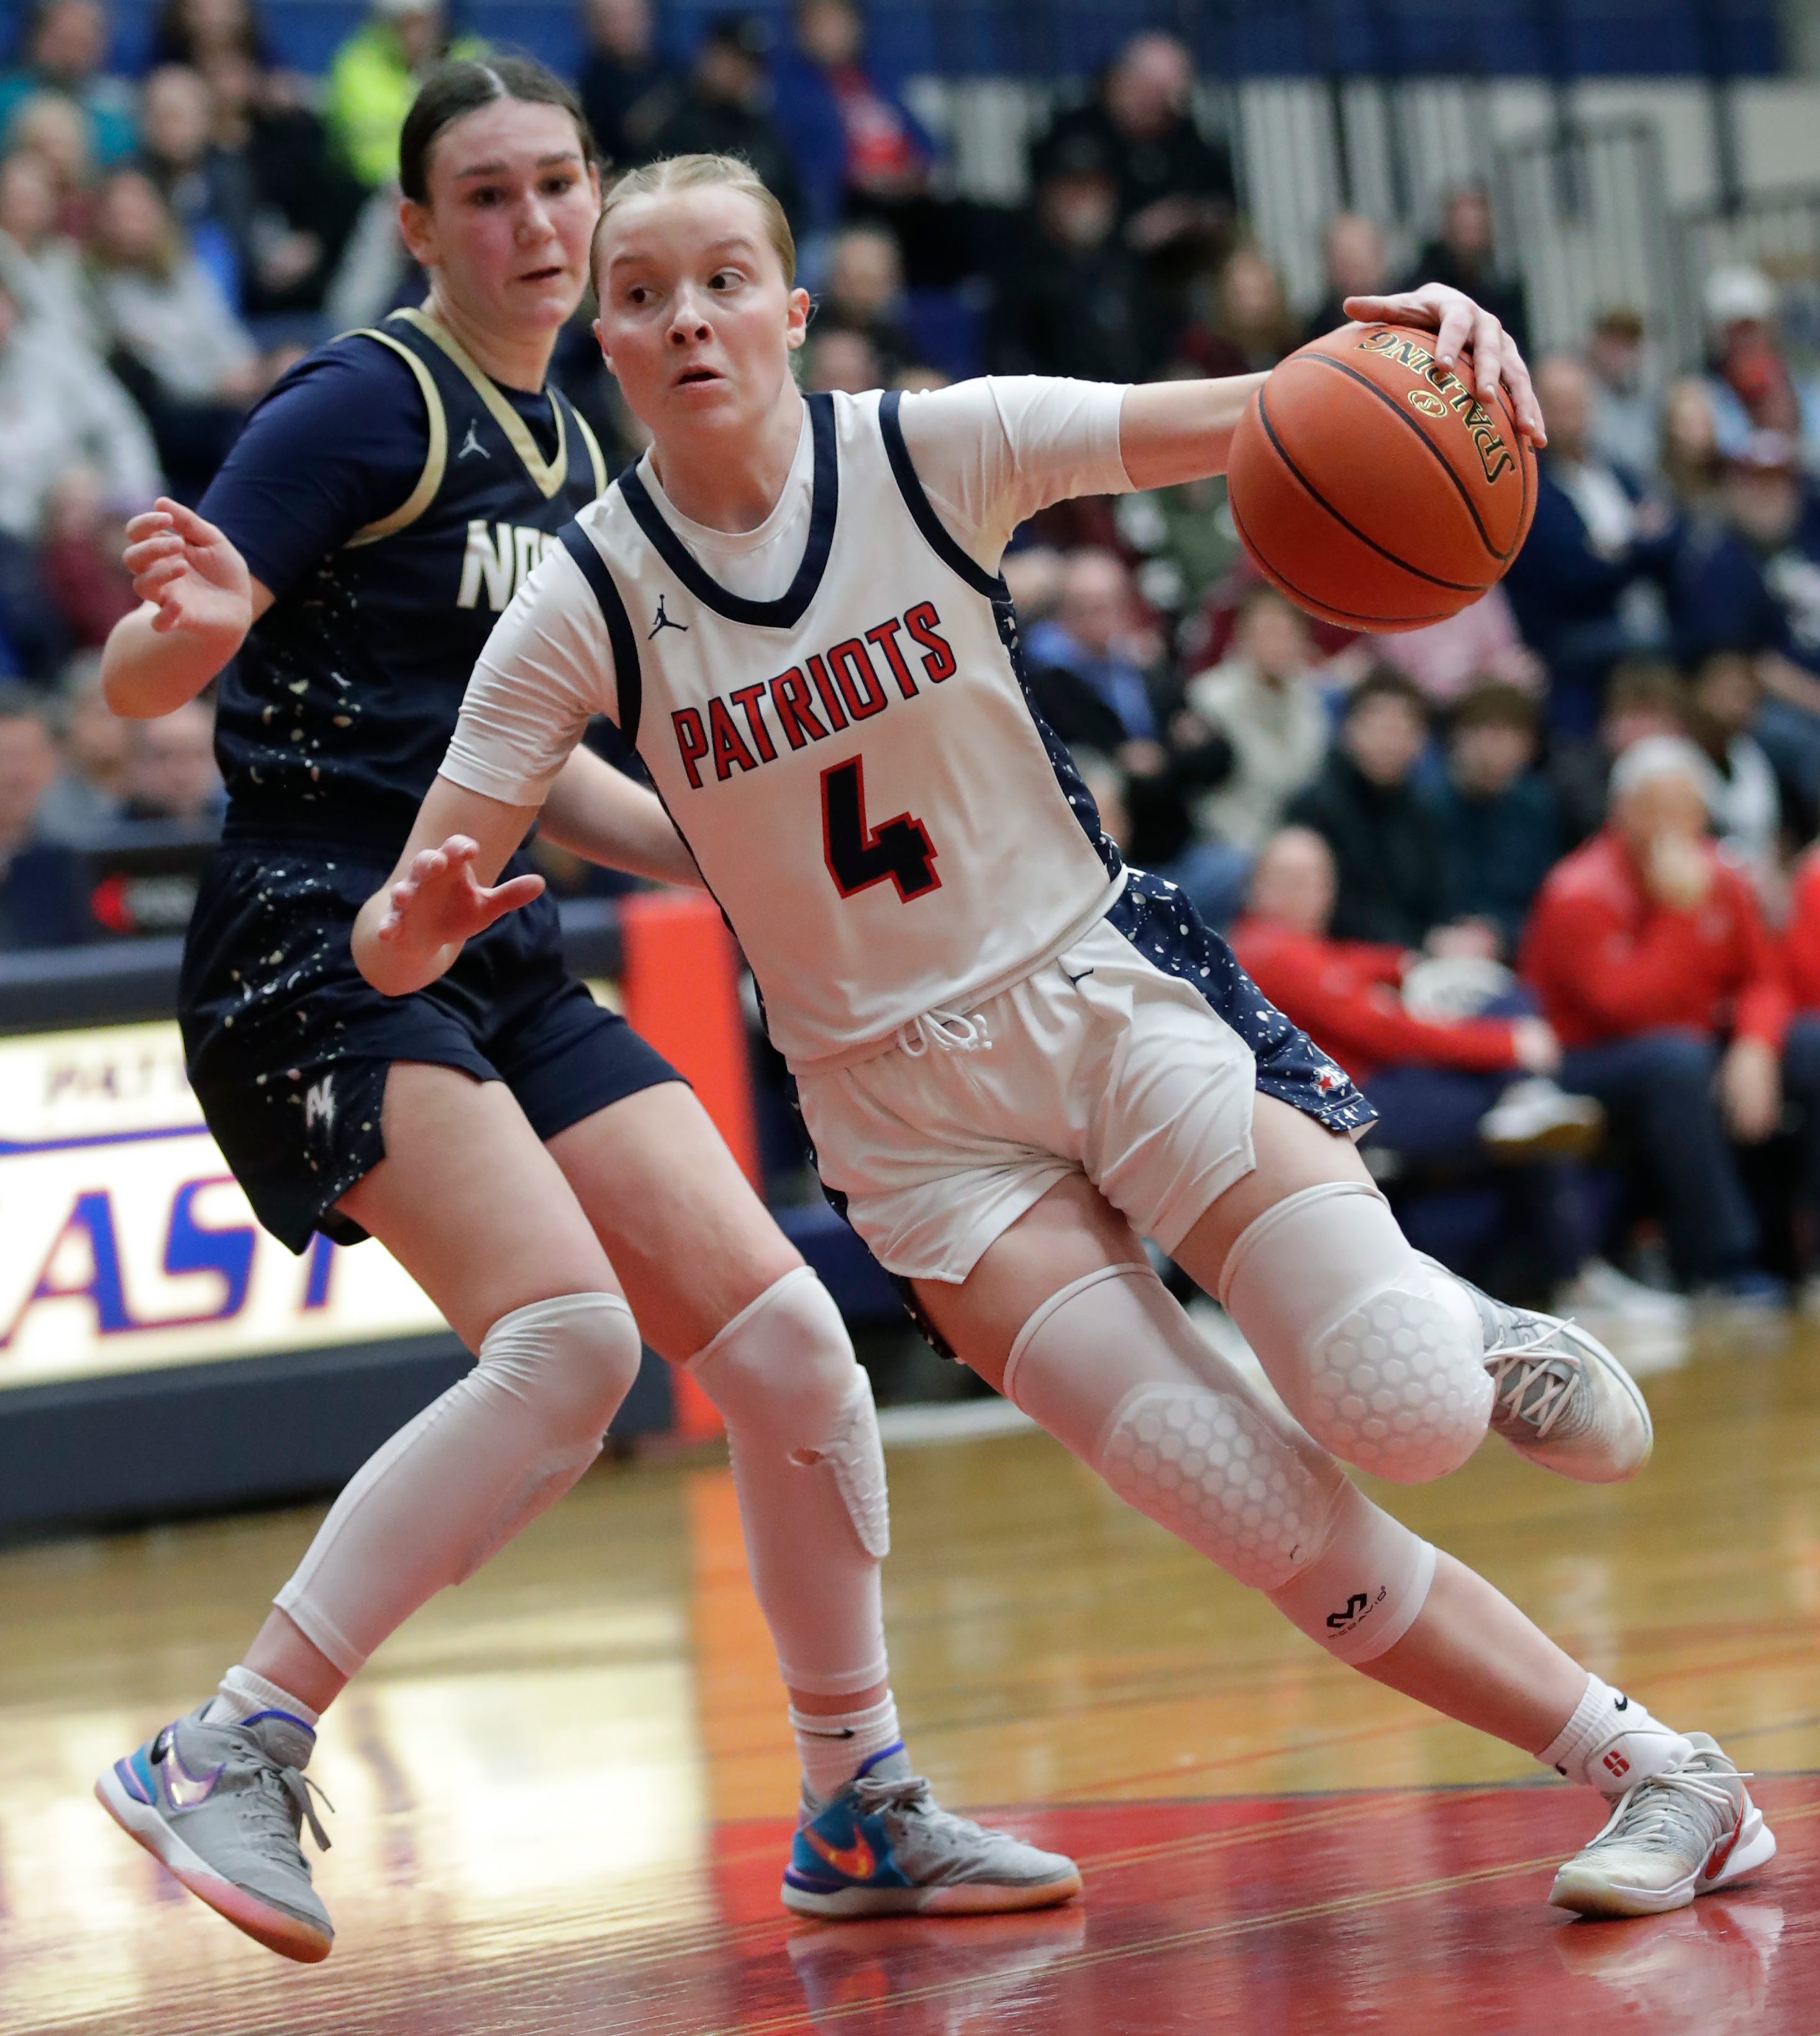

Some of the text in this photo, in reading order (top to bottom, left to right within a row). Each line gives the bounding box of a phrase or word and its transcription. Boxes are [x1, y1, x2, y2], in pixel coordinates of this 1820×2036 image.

[1354, 330, 1516, 486] SPALDING
[457, 519, 558, 612] NO
[671, 601, 957, 789] PATRIOTS
[820, 753, 942, 904] 4
